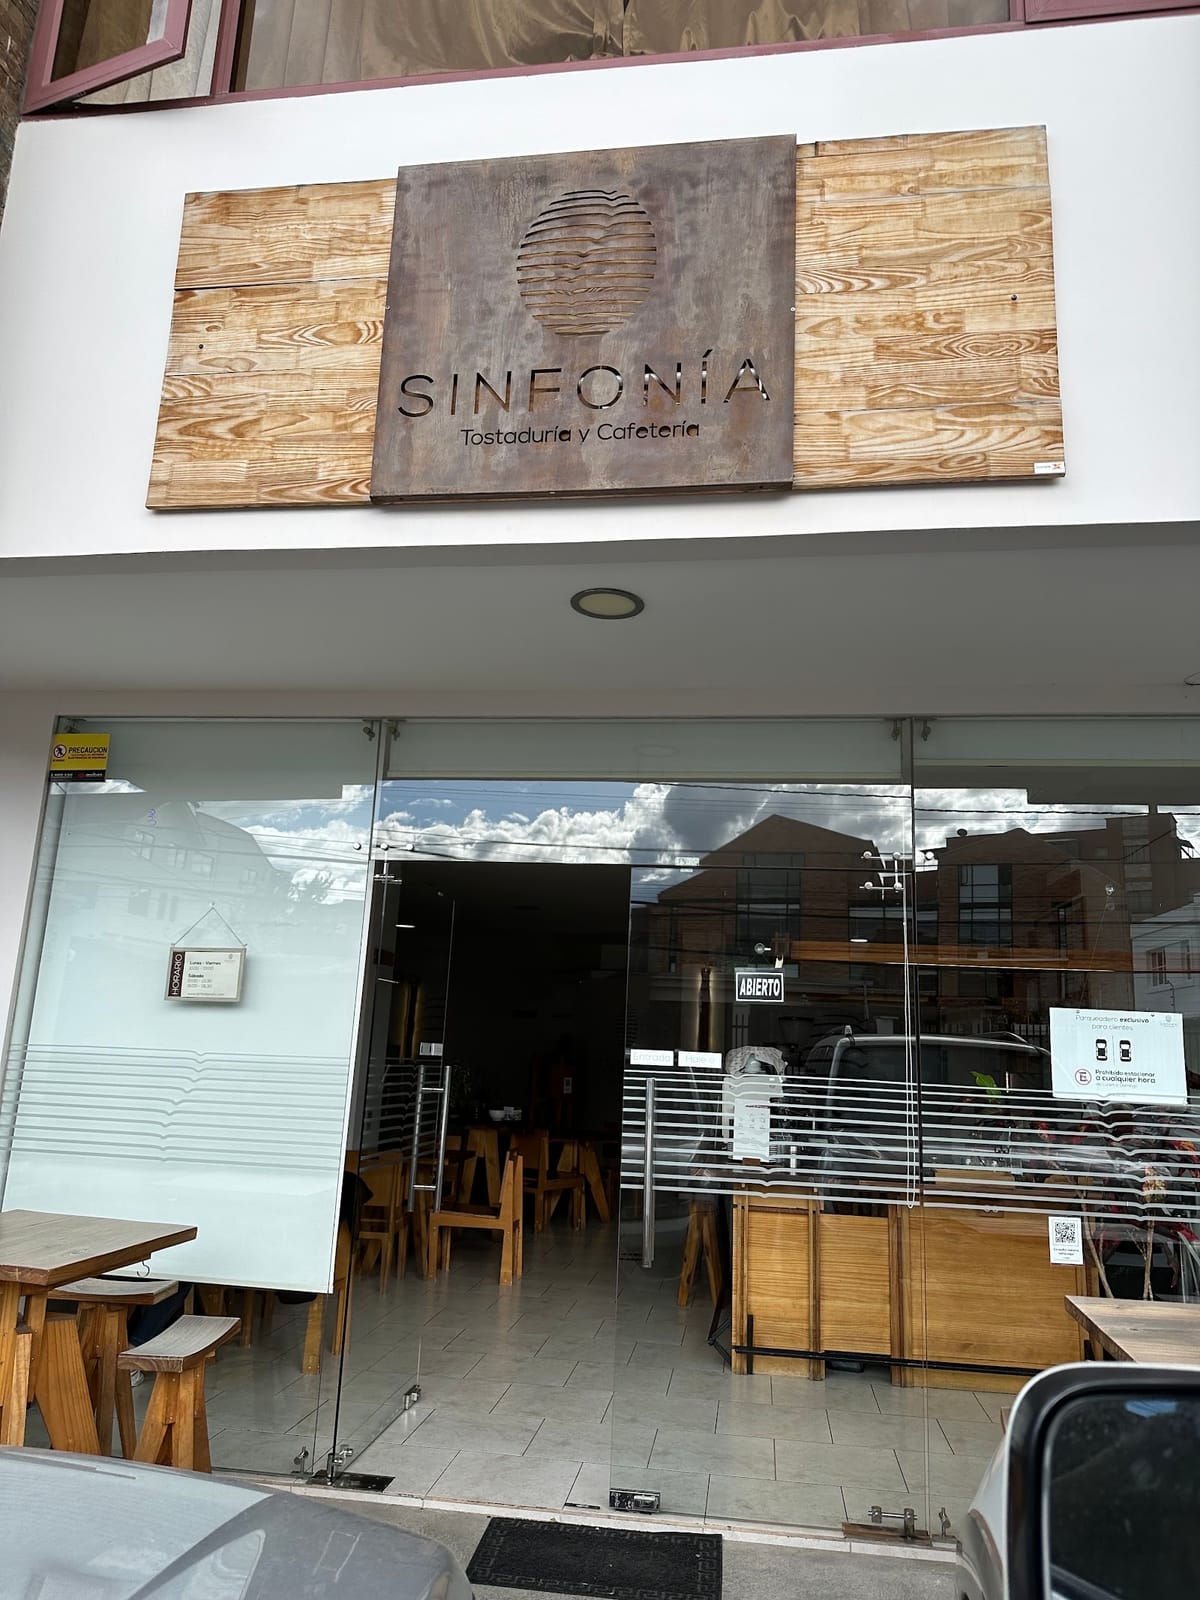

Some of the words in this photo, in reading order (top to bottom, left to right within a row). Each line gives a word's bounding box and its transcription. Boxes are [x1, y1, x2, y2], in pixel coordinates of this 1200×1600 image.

[397, 349, 771, 418] SINFONÍA
[460, 425, 572, 446] Tostaduría
[579, 428, 590, 443] y
[597, 420, 700, 441] Cafetería
[171, 953, 183, 995] HORARIO
[739, 978, 781, 997] ABIERTO
[1075, 1014, 1119, 1024] Parqueadero
[1091, 1023, 1108, 1031] para
[1101, 1075, 1137, 1084] cualquier
